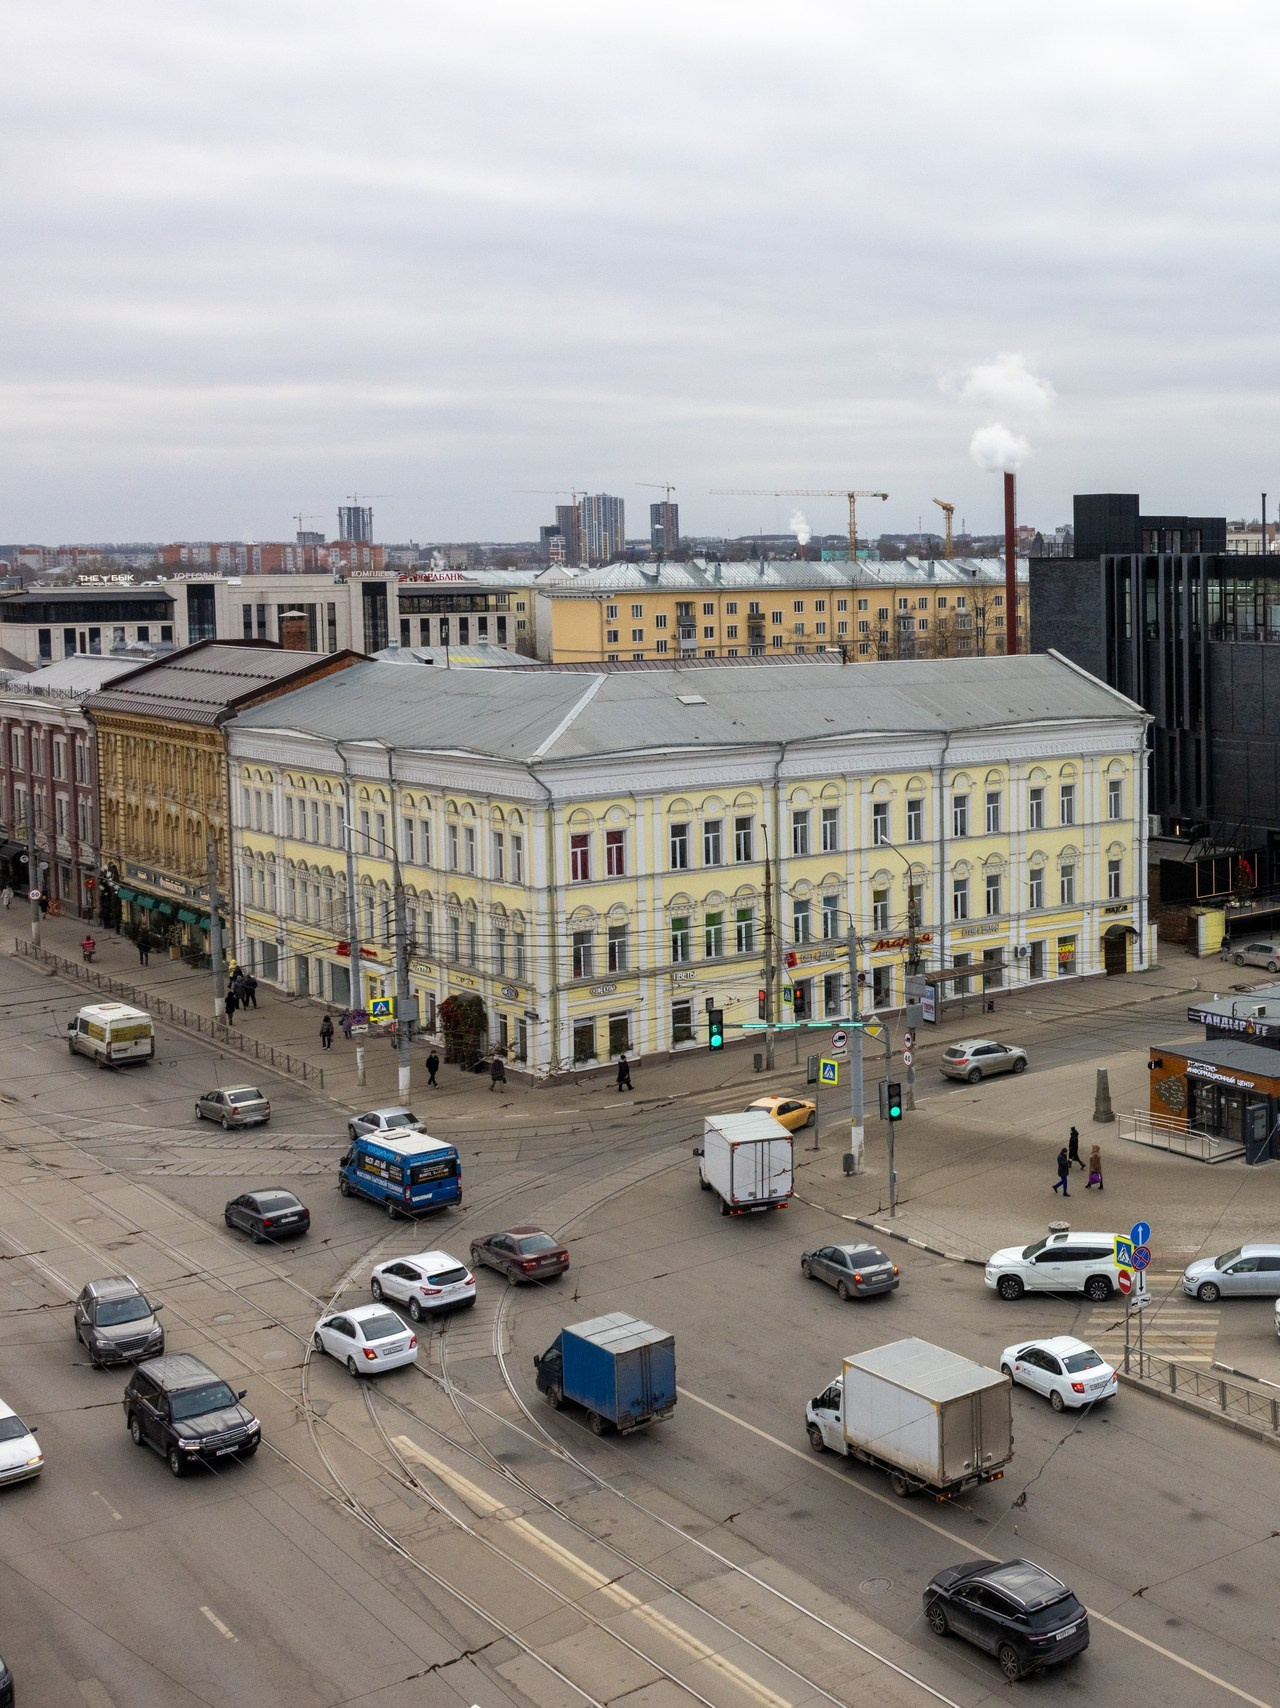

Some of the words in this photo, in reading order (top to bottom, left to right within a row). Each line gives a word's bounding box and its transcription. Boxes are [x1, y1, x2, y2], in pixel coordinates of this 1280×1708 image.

[111, 574, 135, 582] БЫК
[173, 571, 223, 580] ТОРГОВЫЙ
[1105, 904, 1129, 914] MAJOR
[673, 970, 697, 981] ЦВЕТЫ
[1187, 1067, 1236, 1084] ИНФОРМАЦИОННЫЙ
[1236, 1077, 1255, 1089] ЦЕНТР
